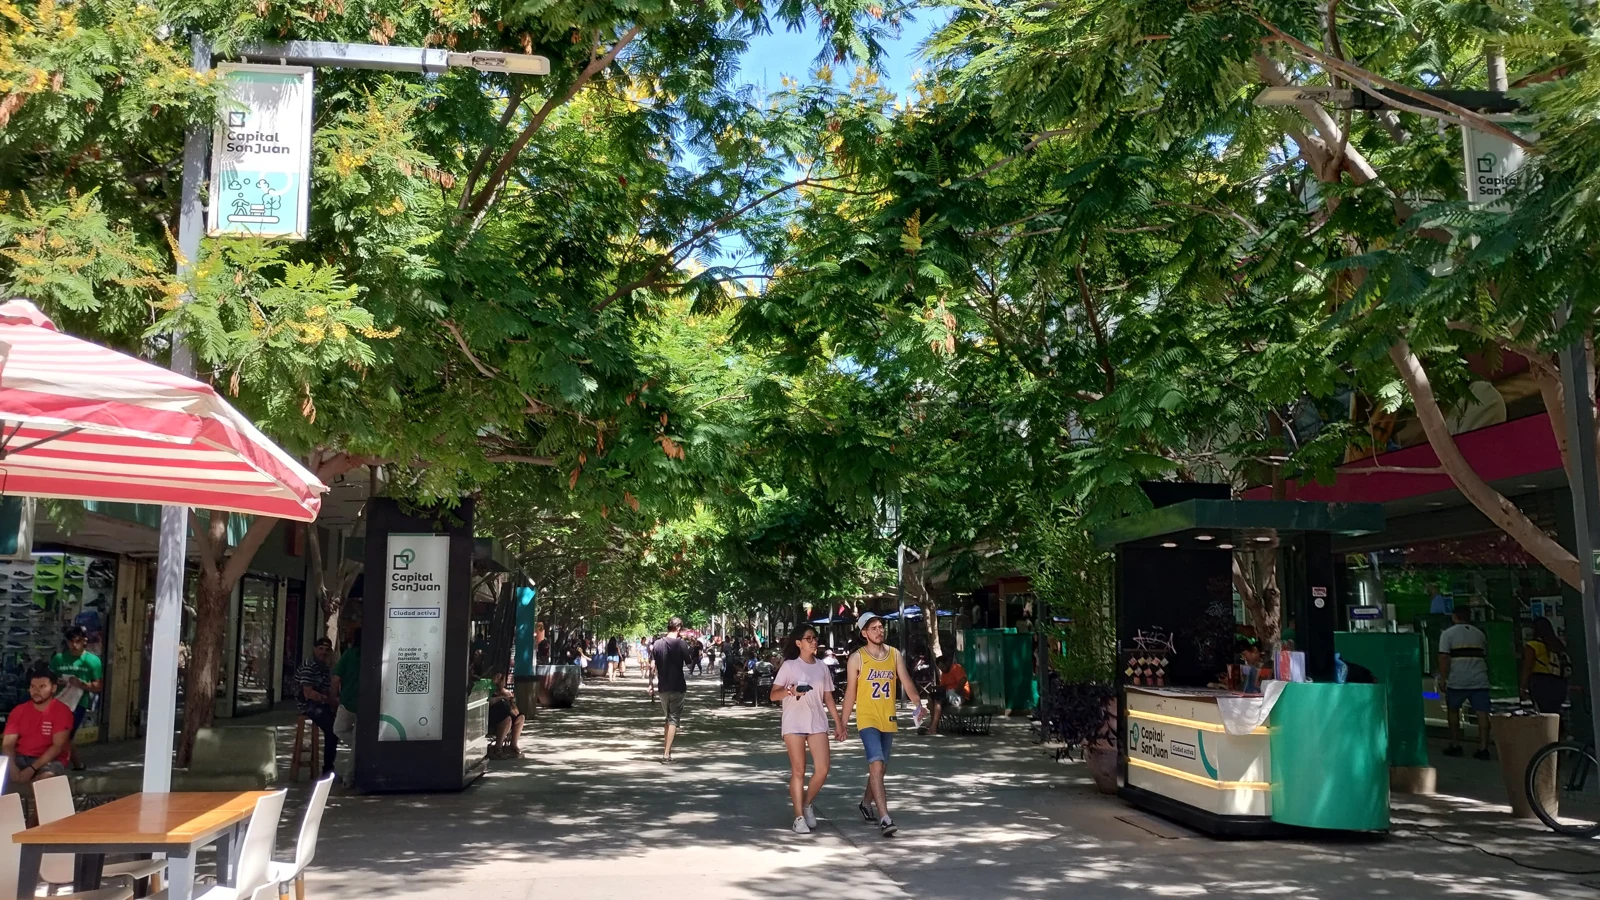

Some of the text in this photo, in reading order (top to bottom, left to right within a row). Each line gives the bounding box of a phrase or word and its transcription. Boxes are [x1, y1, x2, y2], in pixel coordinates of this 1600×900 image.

[227, 131, 280, 144] Capital
[226, 143, 290, 154] SanJuan
[391, 572, 433, 584] Capital
[391, 582, 441, 593] SanJuan
[866, 668, 895, 682] LAKERS
[872, 682, 891, 699] 24
[1141, 726, 1164, 743] Capital
[1141, 741, 1169, 760] SanJuan
[1172, 745, 1194, 756] Ciudad activa
